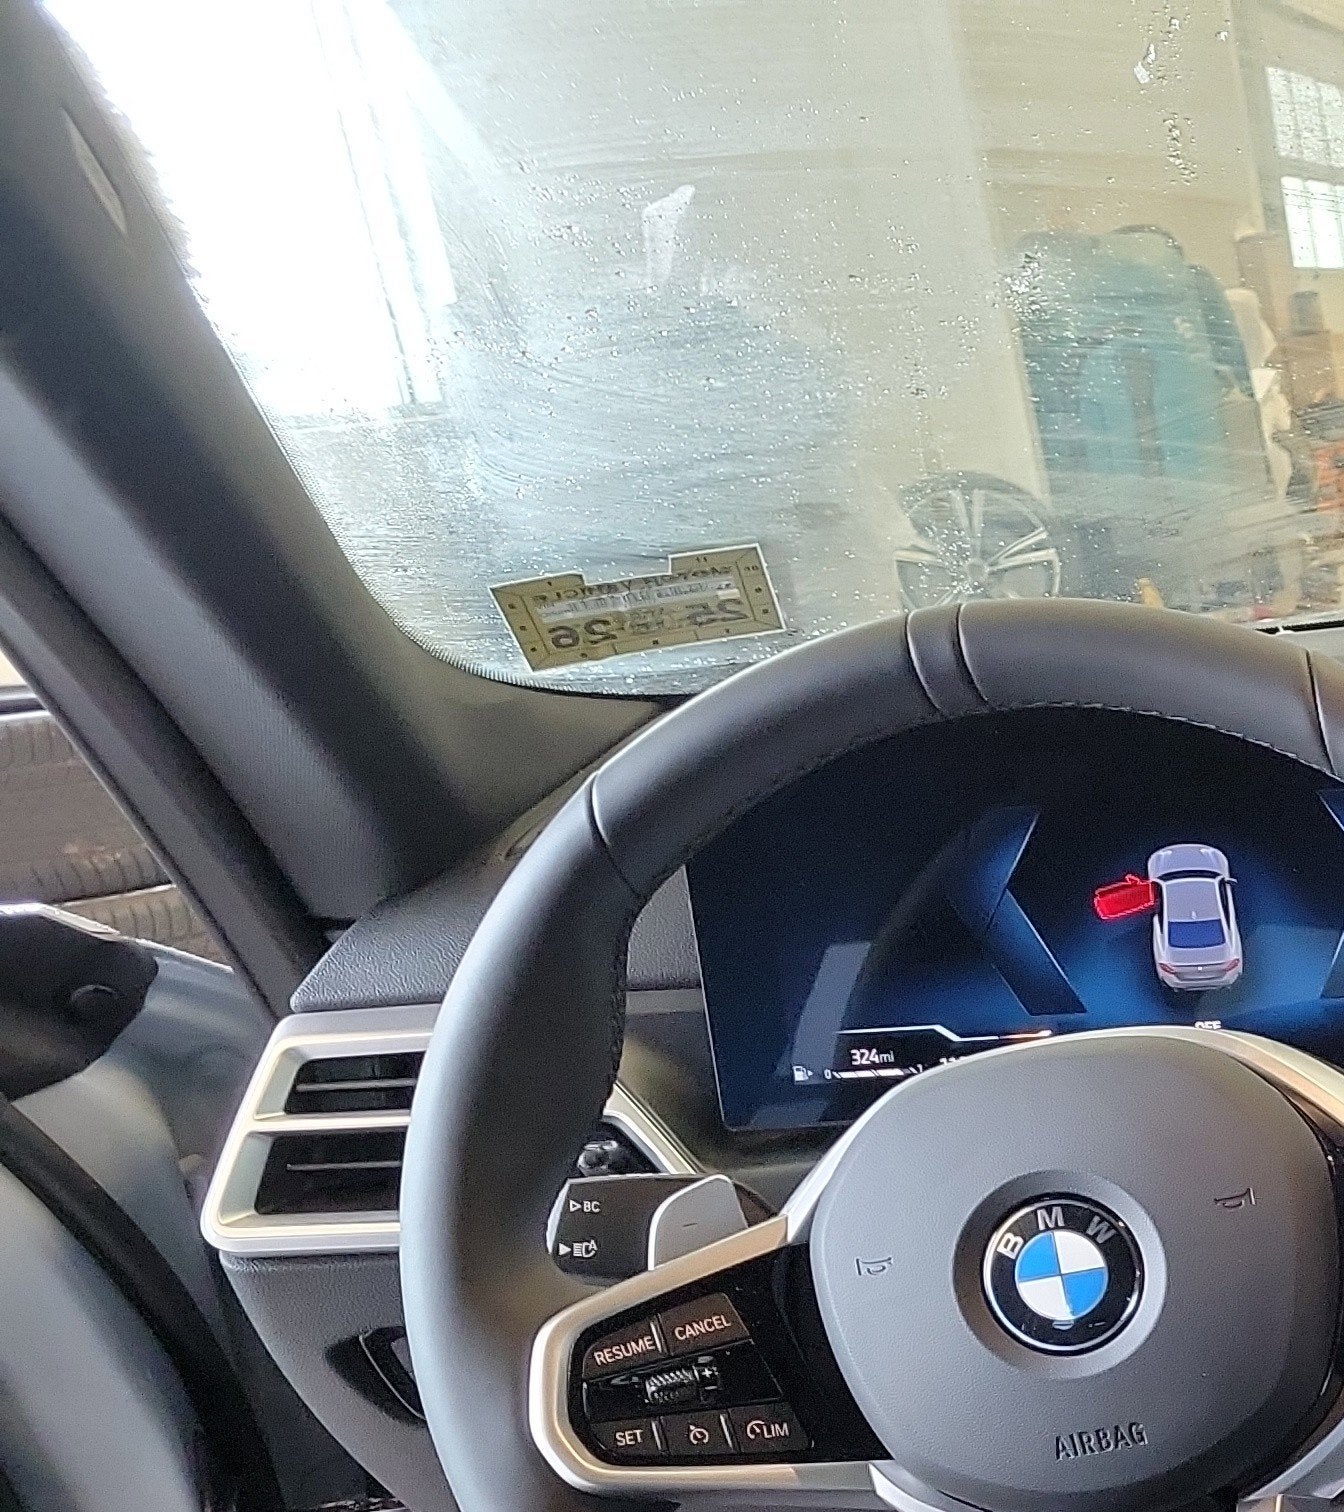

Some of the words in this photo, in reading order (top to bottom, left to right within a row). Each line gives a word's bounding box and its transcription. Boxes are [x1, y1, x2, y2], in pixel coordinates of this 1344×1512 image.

[583, 1201, 601, 1213] BC
[997, 1206, 1117, 1260] BMW
[674, 1315, 731, 1341] CANCEL
[594, 1336, 656, 1365] RESUME
[615, 1429, 643, 1446] SET
[762, 1422, 789, 1438] LIM
[1055, 1422, 1149, 1461] AIRBAG
